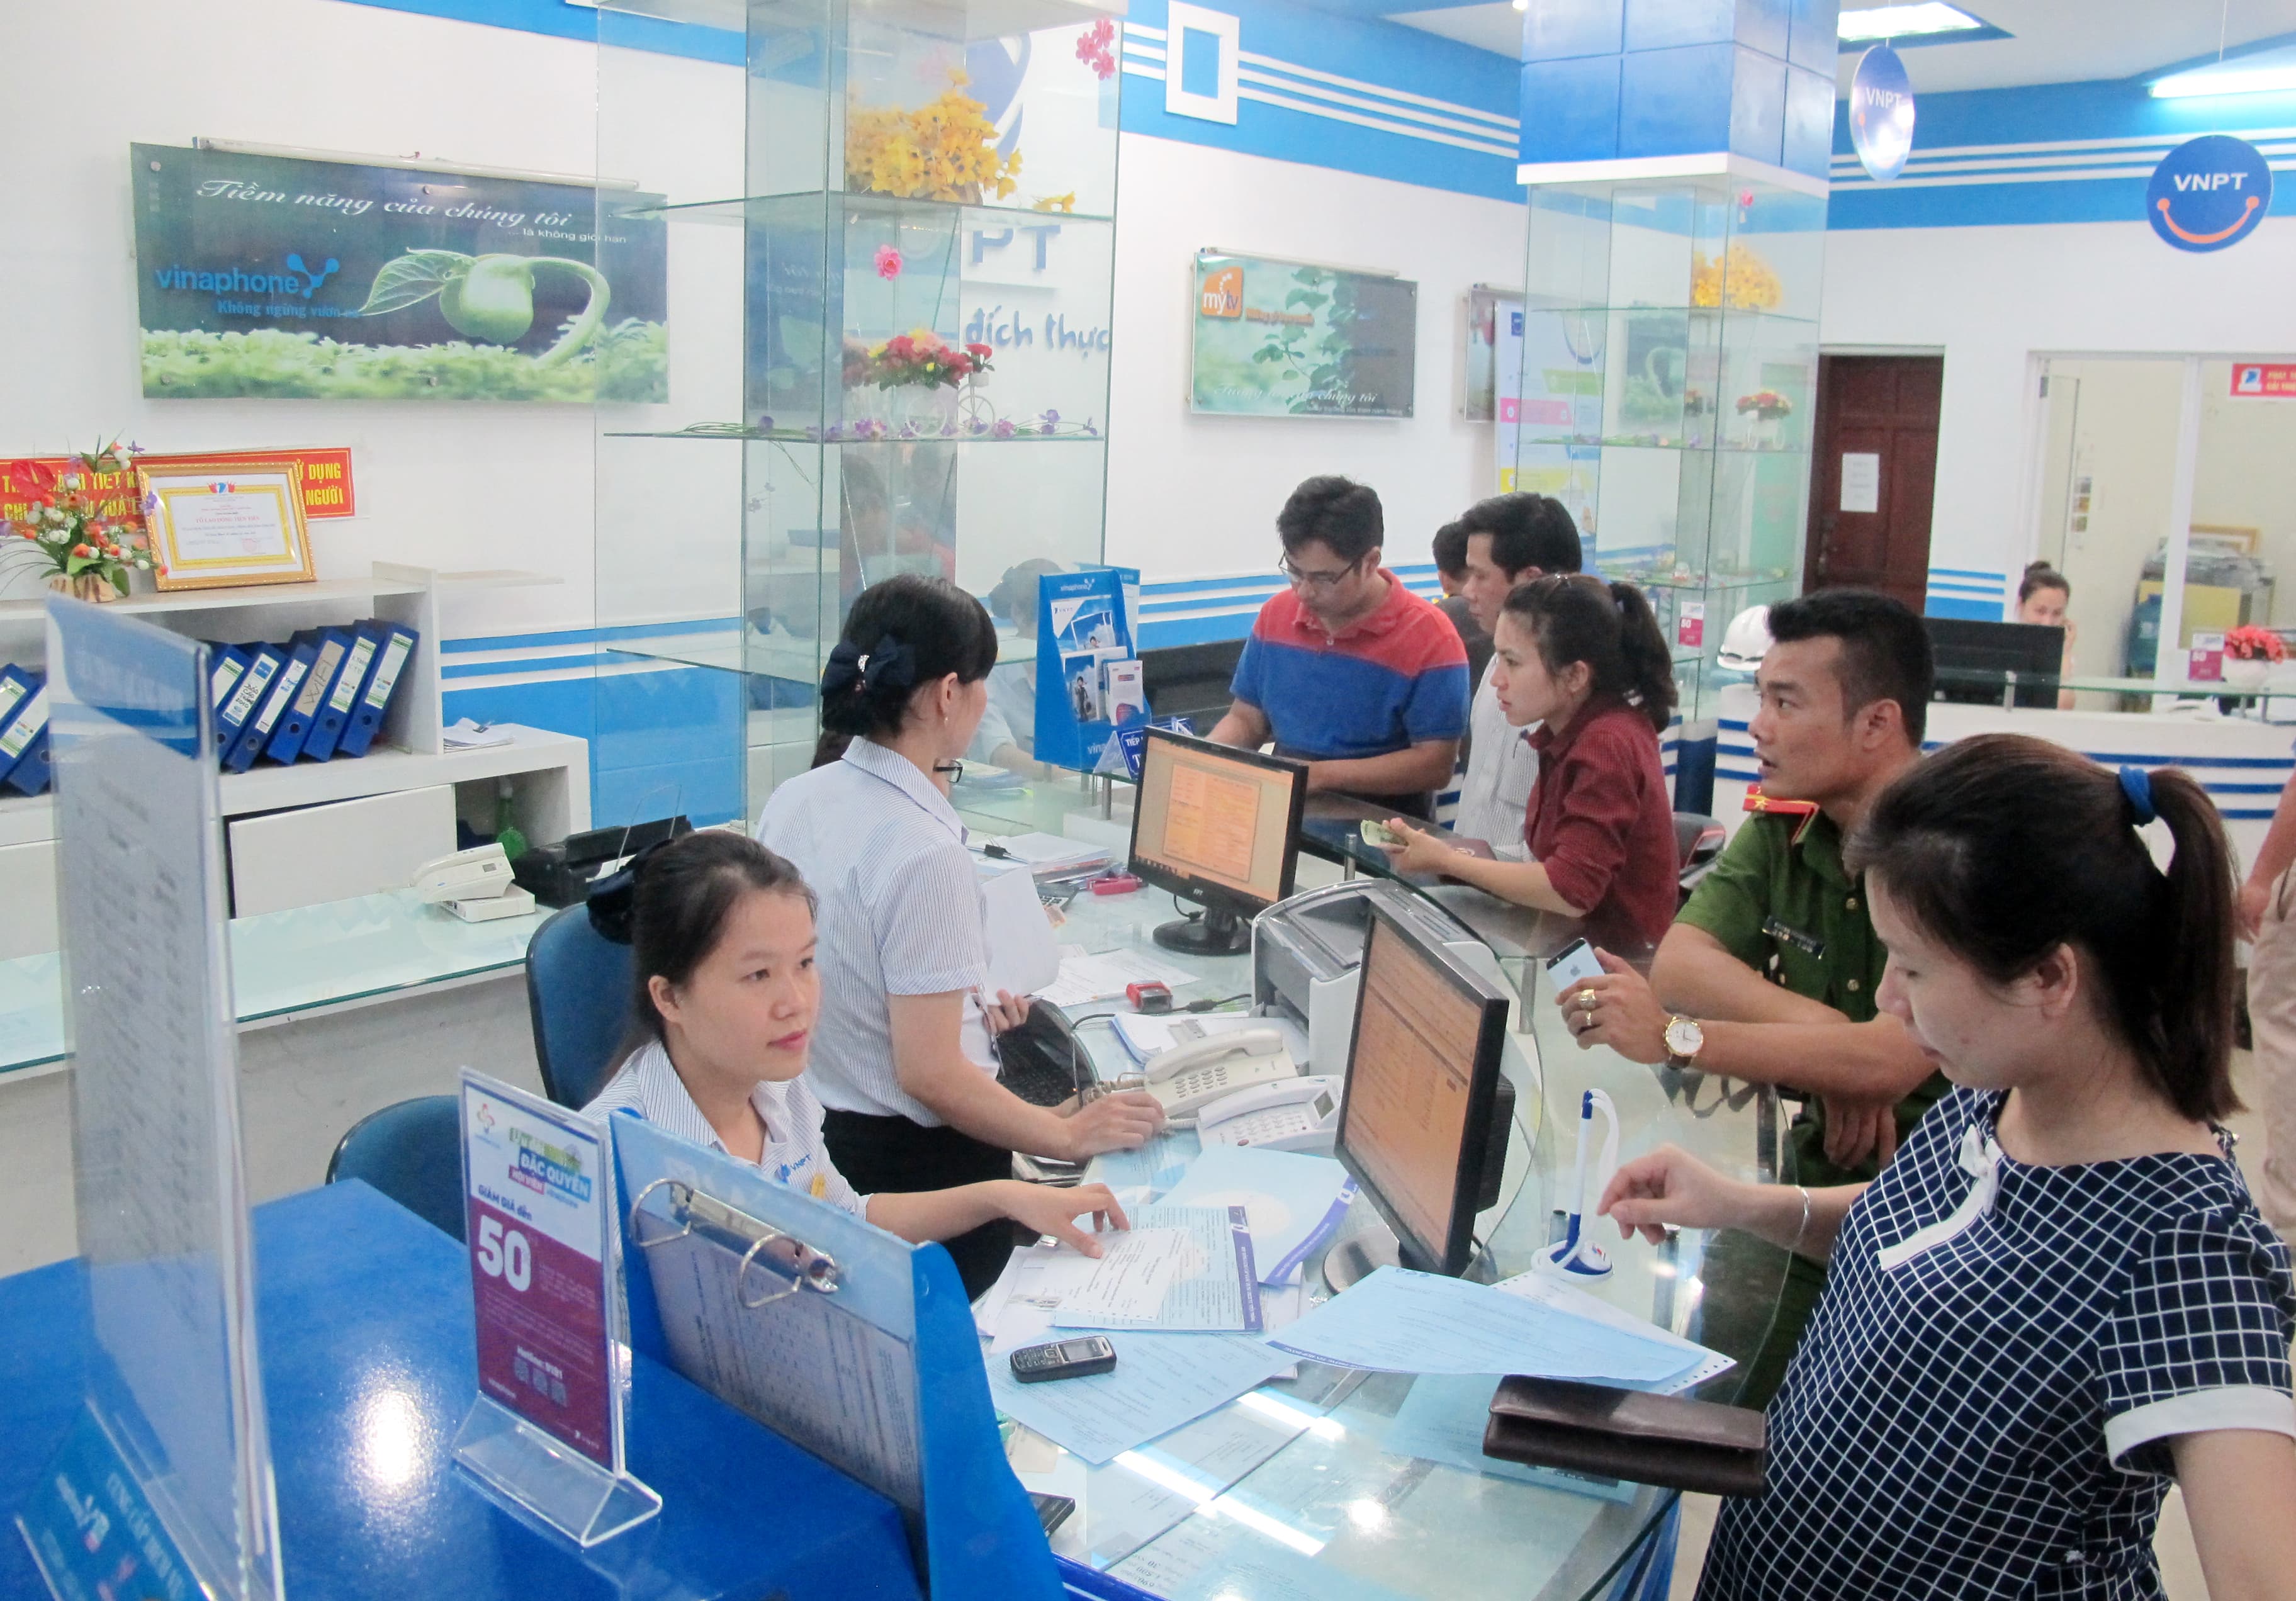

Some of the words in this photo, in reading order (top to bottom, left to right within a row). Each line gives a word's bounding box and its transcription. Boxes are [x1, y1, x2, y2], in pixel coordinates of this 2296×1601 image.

[1866, 87, 1902, 109] VNPT
[2173, 172, 2248, 191] VNPT
[196, 180, 286, 203] Tiềm
[295, 193, 374, 215] năng
[383, 198, 436, 215] của
[444, 202, 526, 228] chúng
[534, 211, 573, 227] tôi
[522, 228, 535, 237] là
[537, 228, 576, 242] không
[155, 264, 300, 295] vinaphone
[308, 463, 342, 484] DỤNG
[305, 484, 344, 506] NGƯỜI
[478, 1214, 532, 1293] 50
